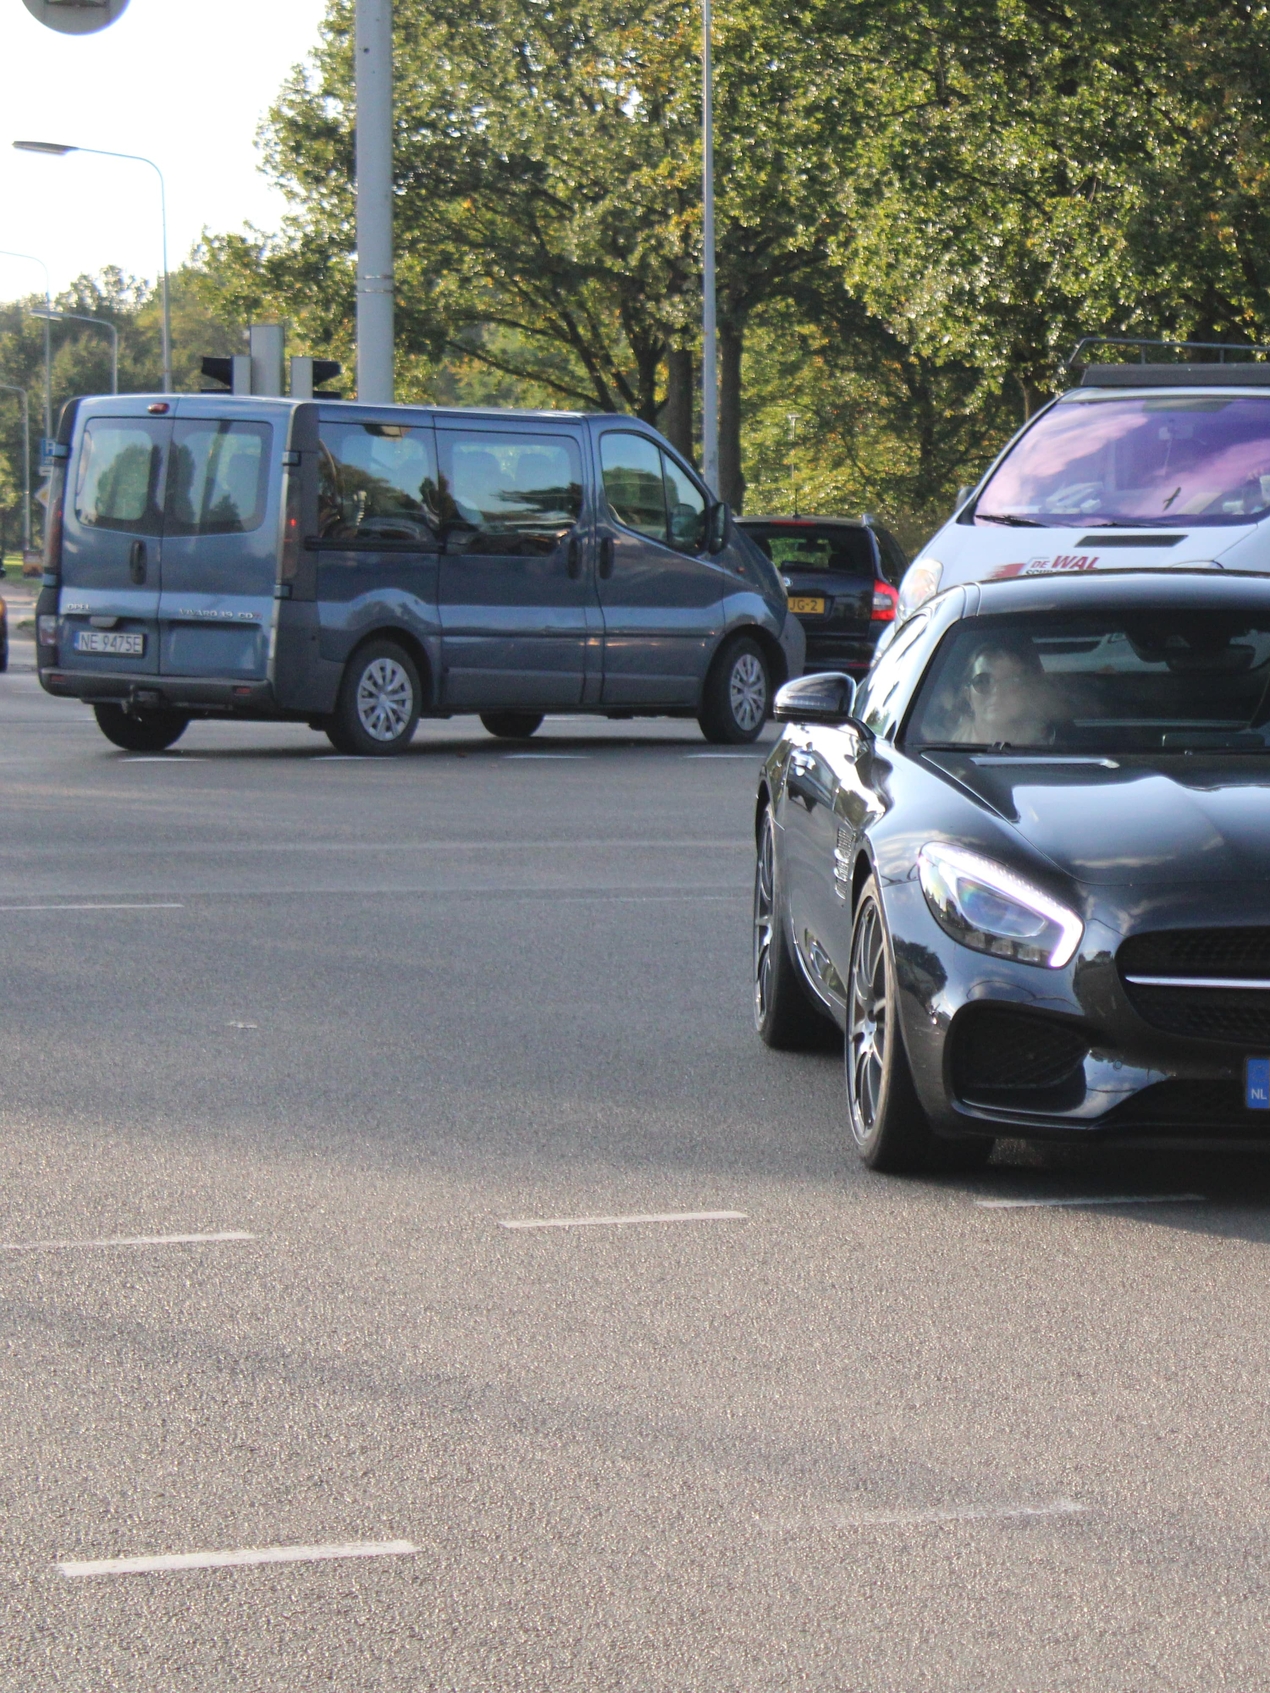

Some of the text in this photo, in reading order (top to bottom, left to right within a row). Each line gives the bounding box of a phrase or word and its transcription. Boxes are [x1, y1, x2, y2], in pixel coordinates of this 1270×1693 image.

[1030, 555, 1100, 570] DE WAL
[81, 634, 141, 653] NE 9475E
[1251, 1088, 1268, 1100] NL
